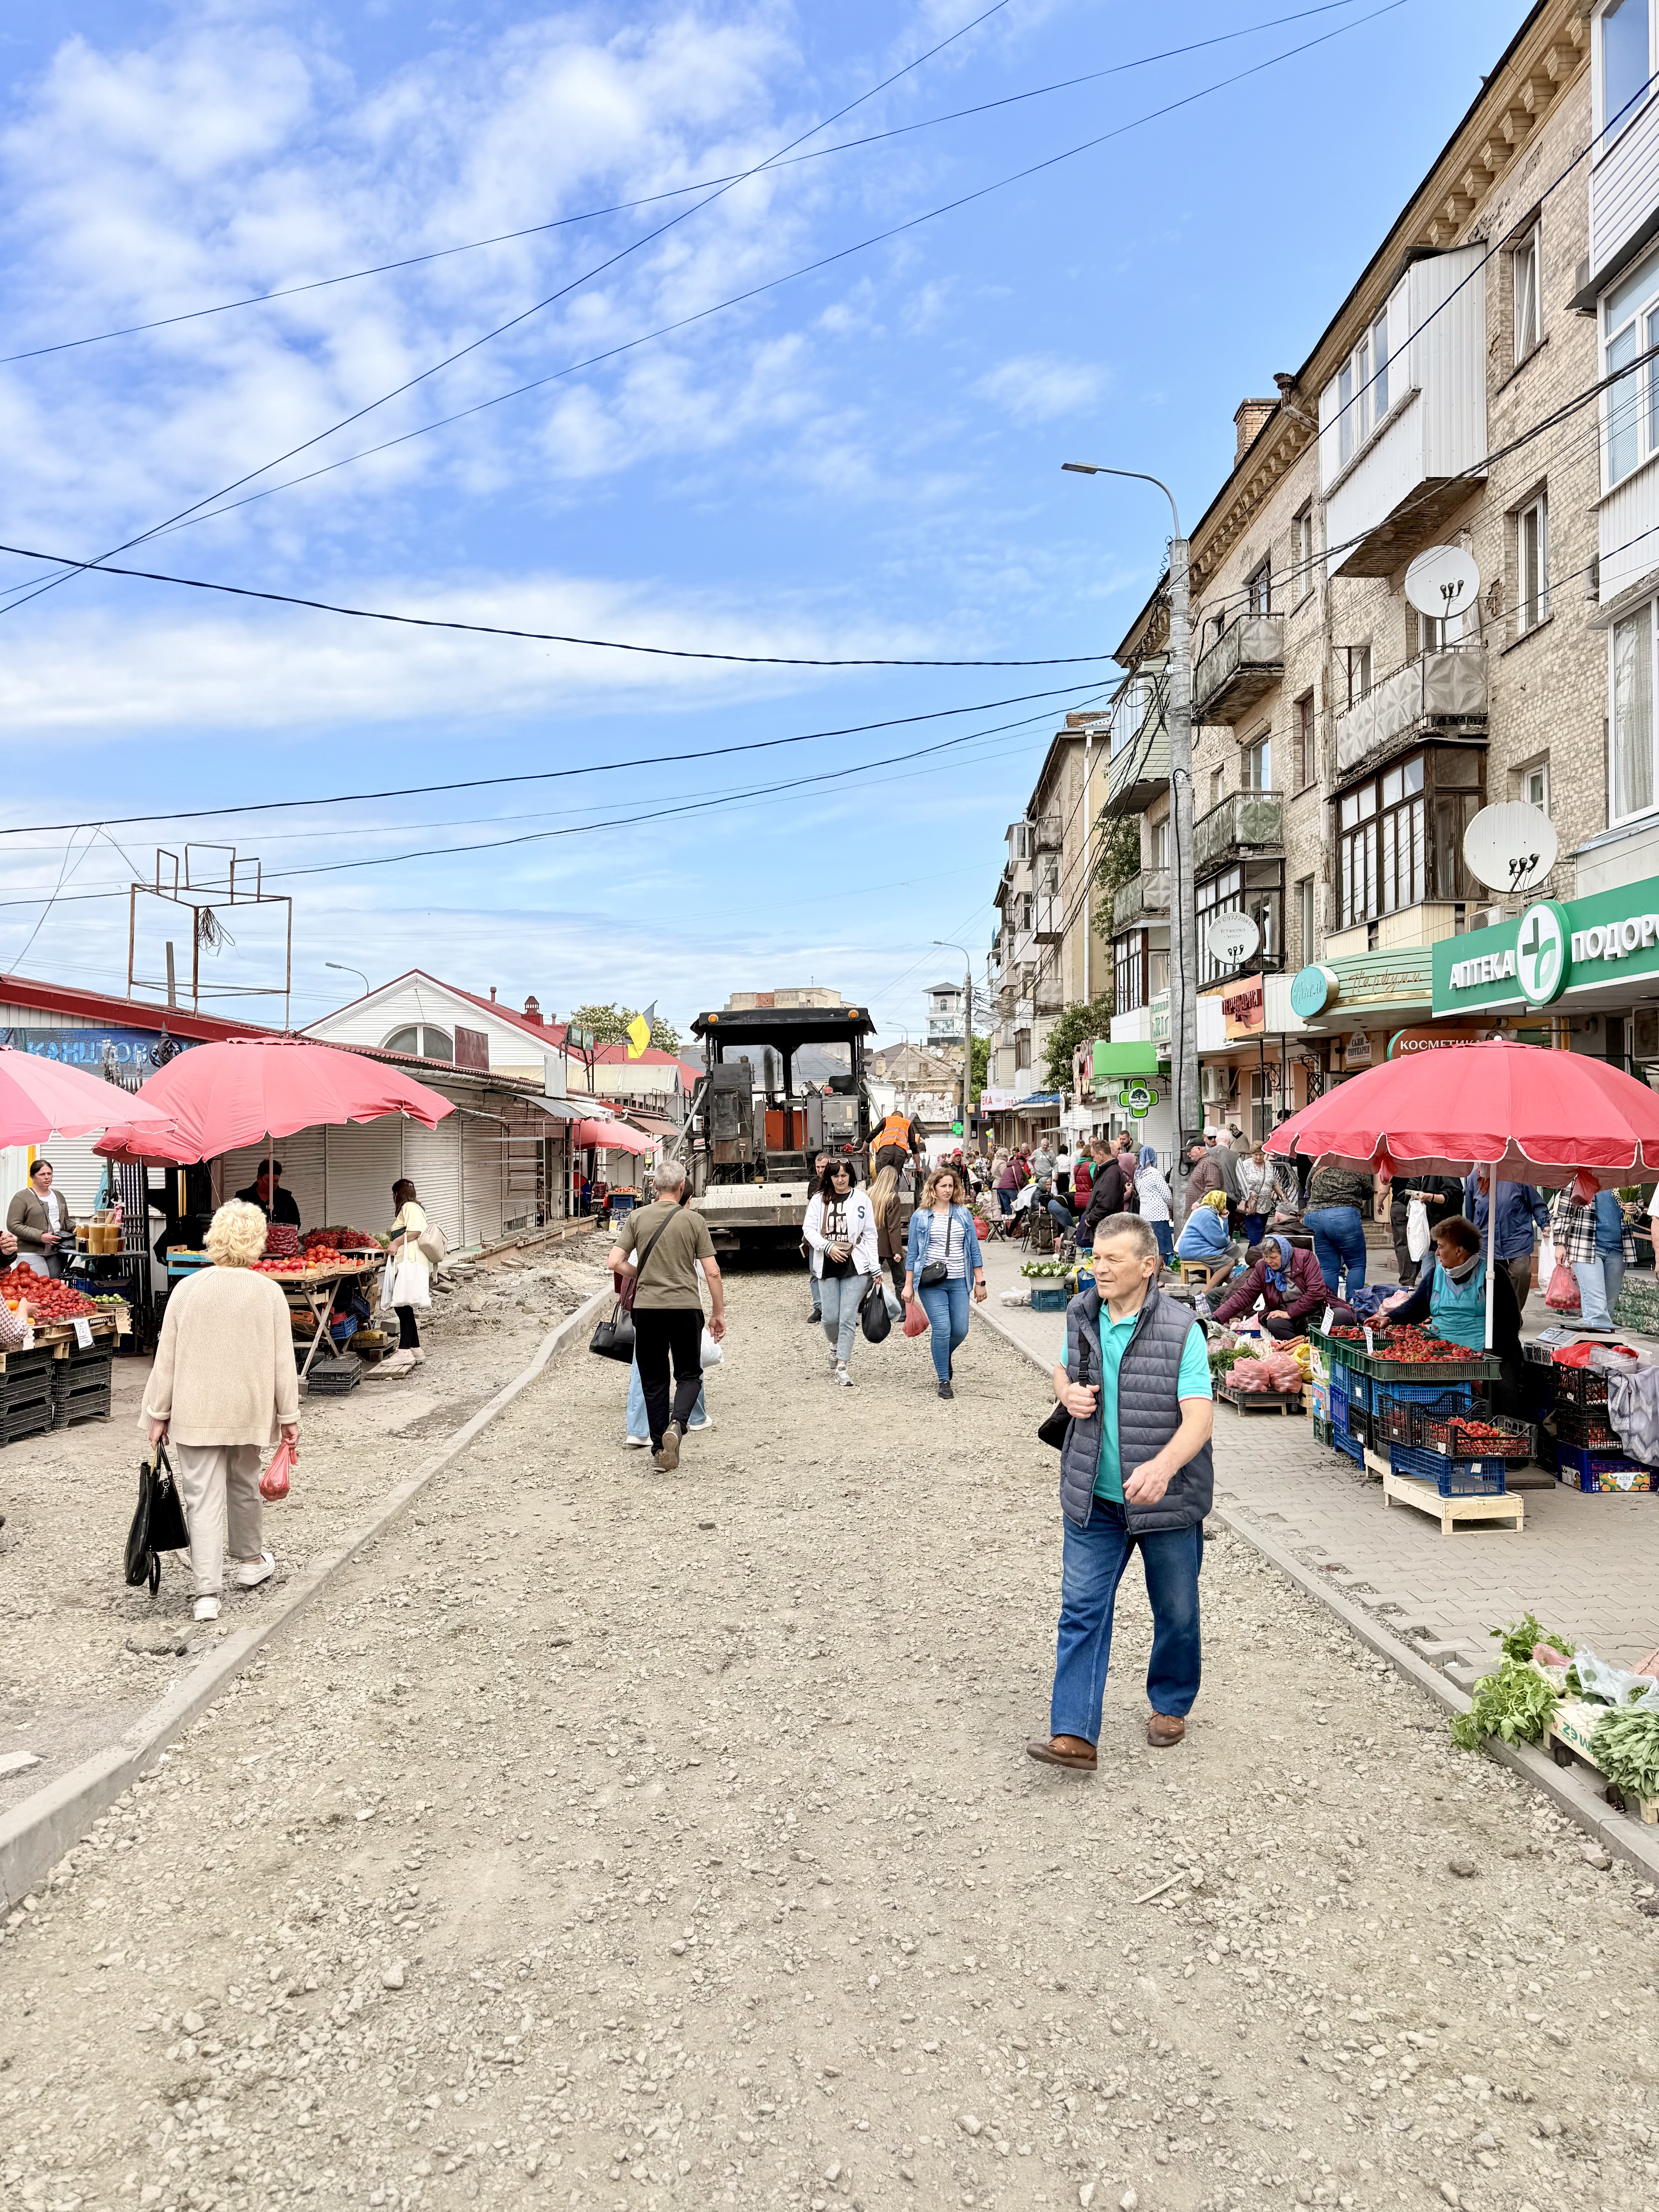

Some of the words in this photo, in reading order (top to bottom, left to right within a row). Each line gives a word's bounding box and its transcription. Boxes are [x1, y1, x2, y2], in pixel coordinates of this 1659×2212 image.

[1449, 950, 1516, 990] АПТЕКА
[1571, 914, 1659, 963] ПОДОР
[858, 1206, 865, 1219] S
